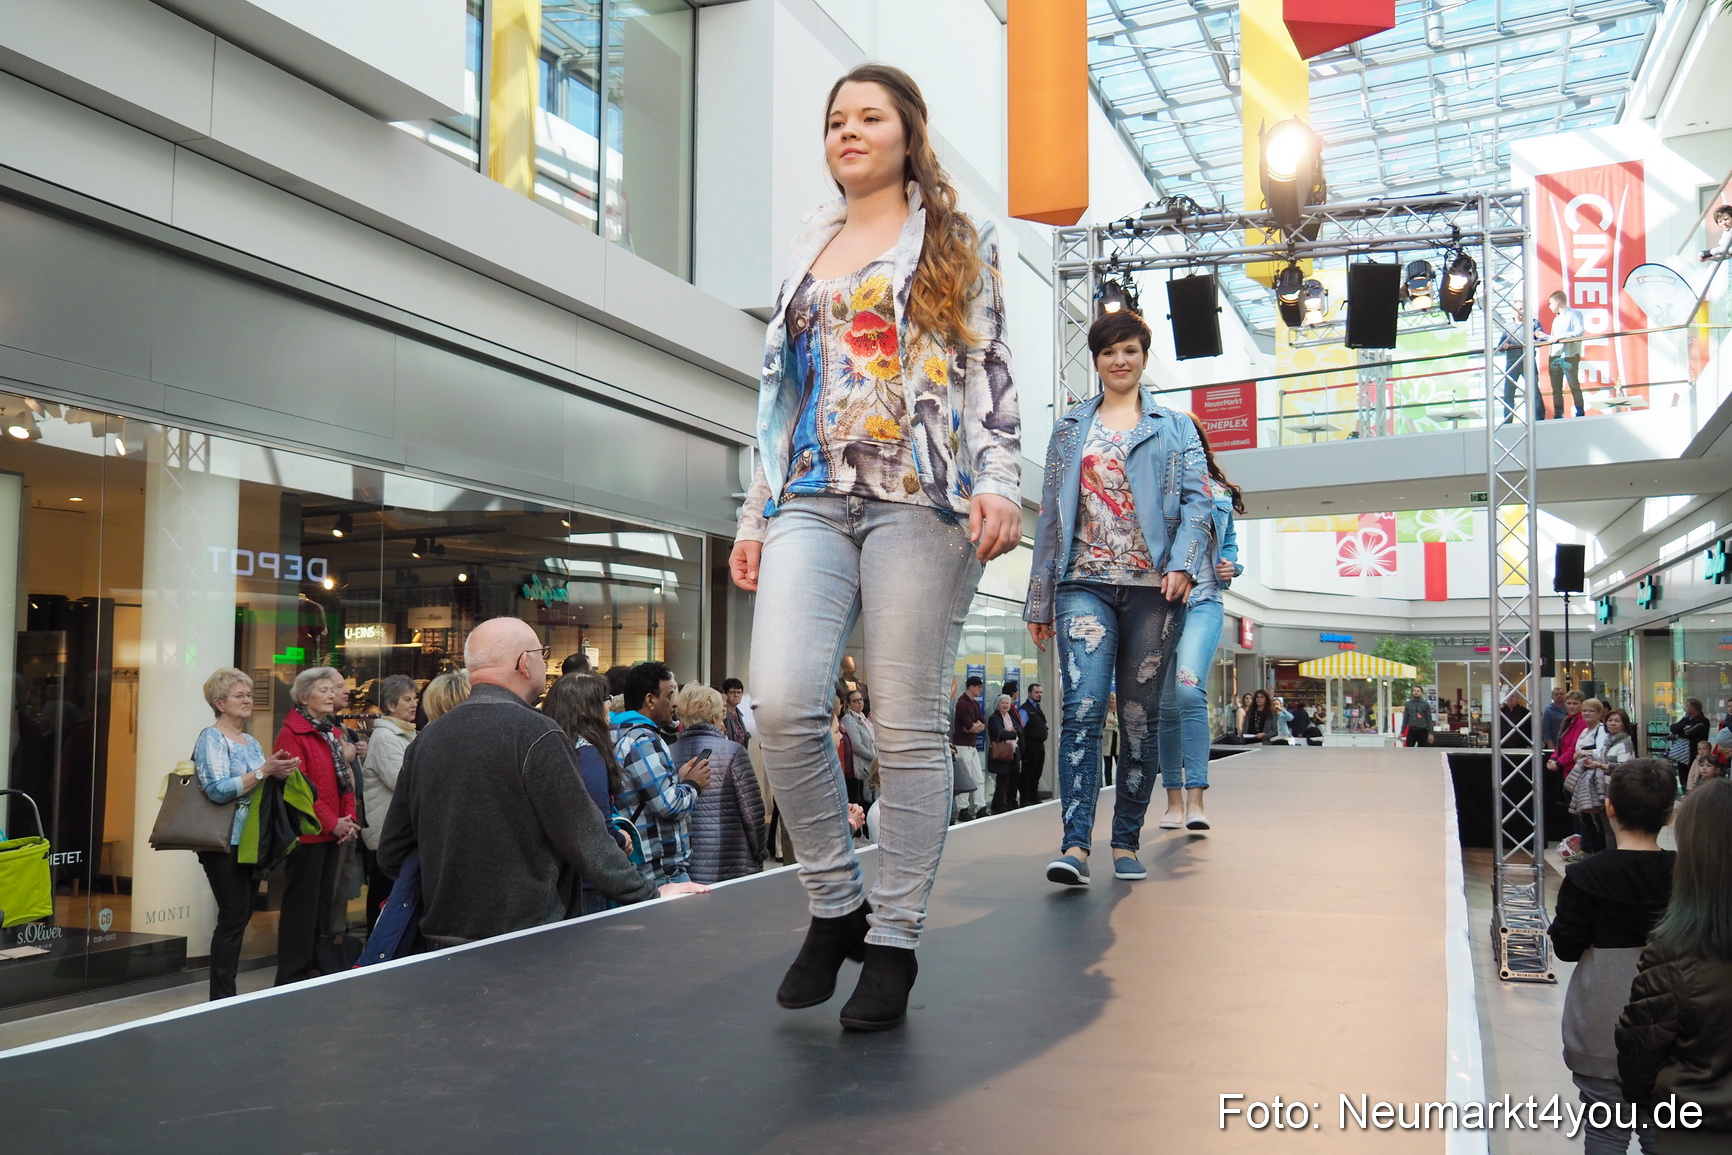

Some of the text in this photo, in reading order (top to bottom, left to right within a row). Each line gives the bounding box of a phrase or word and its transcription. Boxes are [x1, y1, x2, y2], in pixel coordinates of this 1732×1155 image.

[1204, 398, 1242, 408] NeuerMarkt
[1201, 418, 1248, 431] CINEPLEX
[49, 850, 83, 866] IETET.
[101, 912, 111, 925] CG
[145, 905, 191, 925] MONTI
[17, 922, 64, 945] s.Oliver
